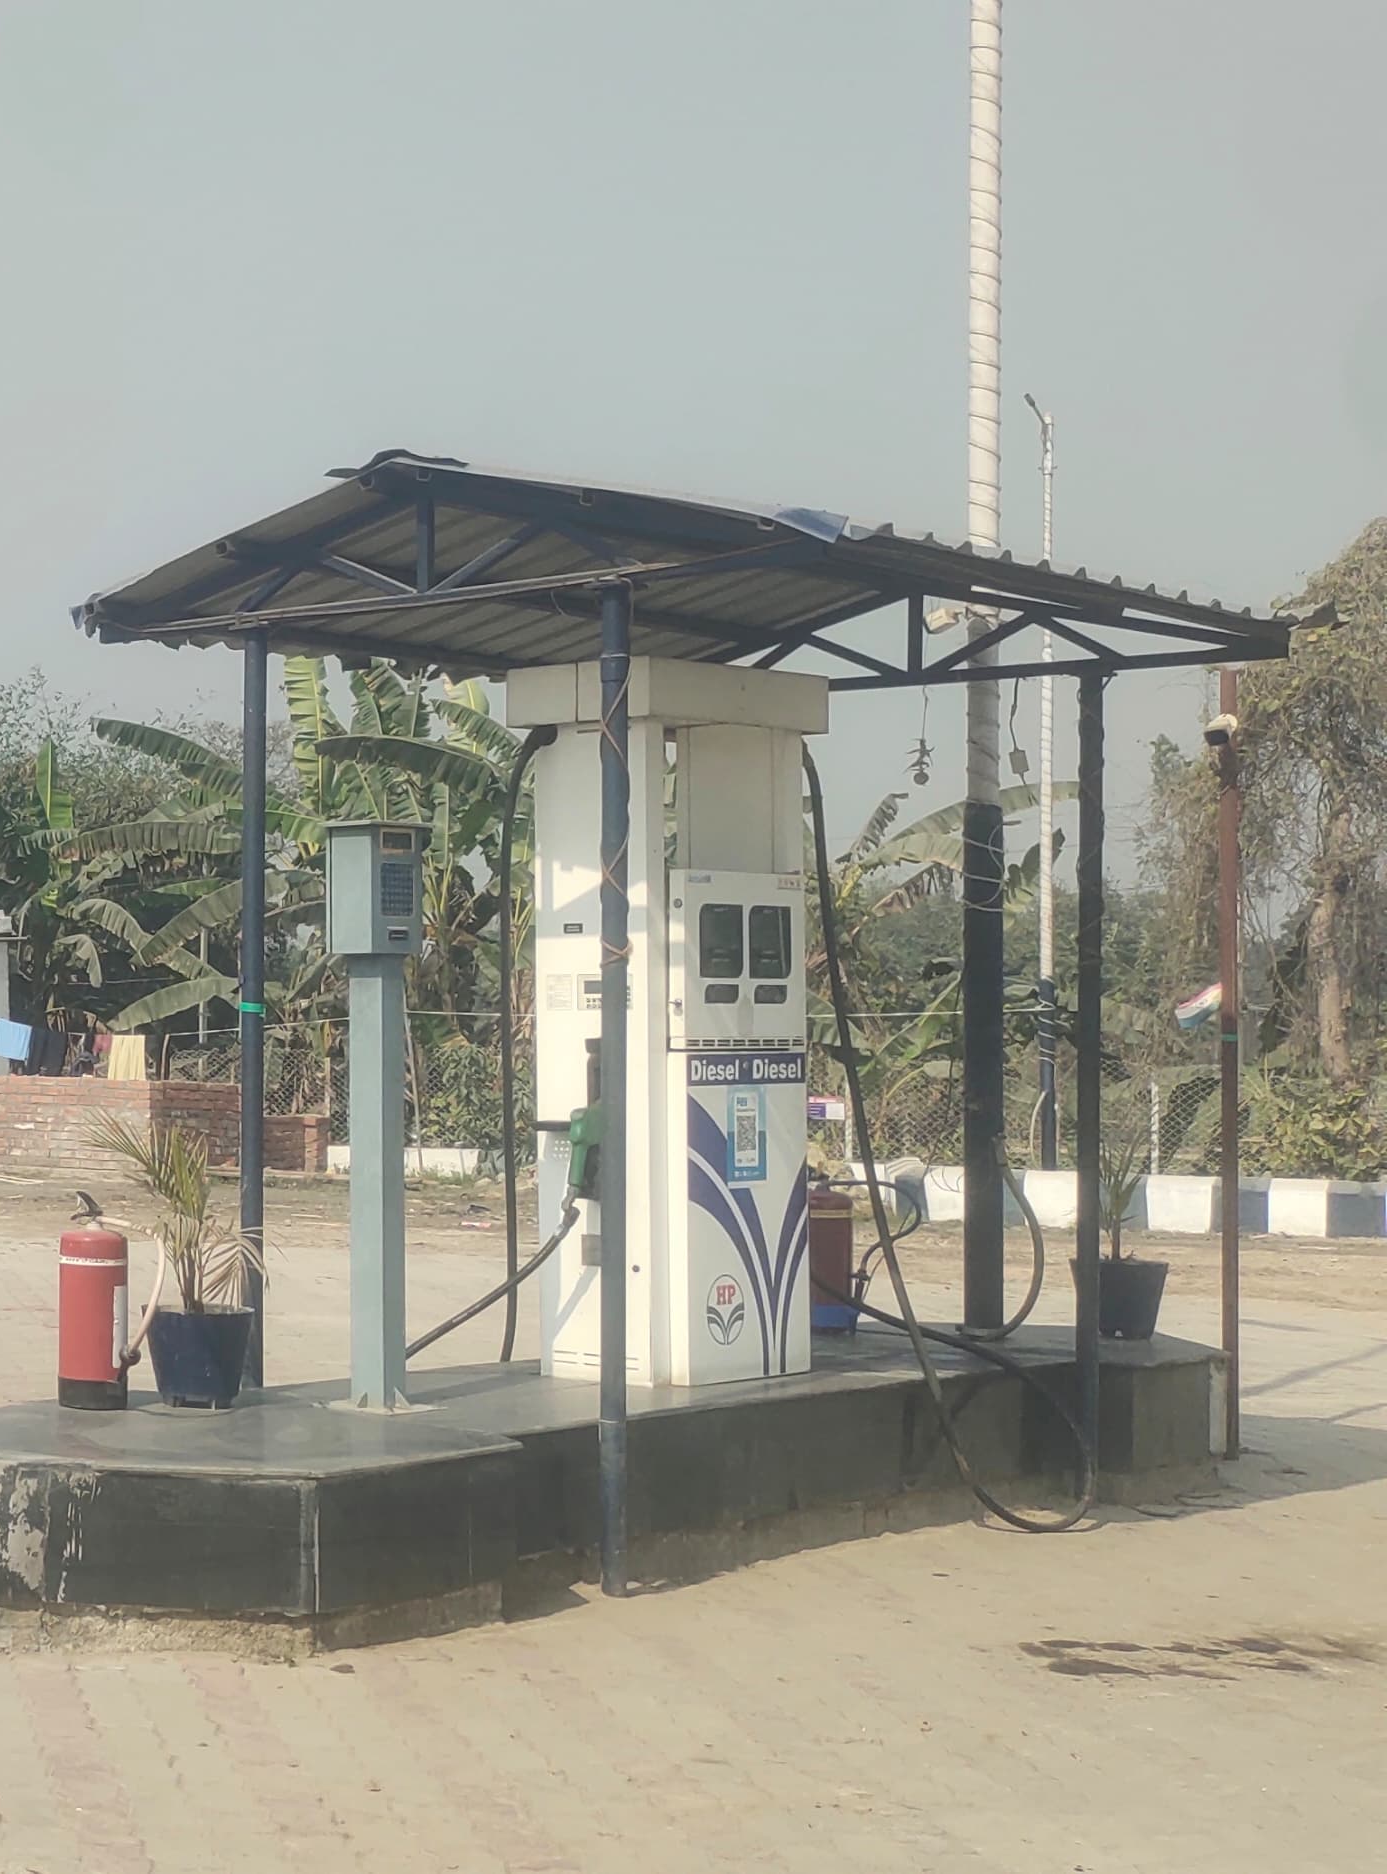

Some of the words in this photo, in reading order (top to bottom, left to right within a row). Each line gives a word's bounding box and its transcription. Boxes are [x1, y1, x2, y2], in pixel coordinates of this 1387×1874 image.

[690, 1059, 740, 1081] Diesel
[752, 1058, 802, 1080] Diesel
[716, 1284, 736, 1305] HP
